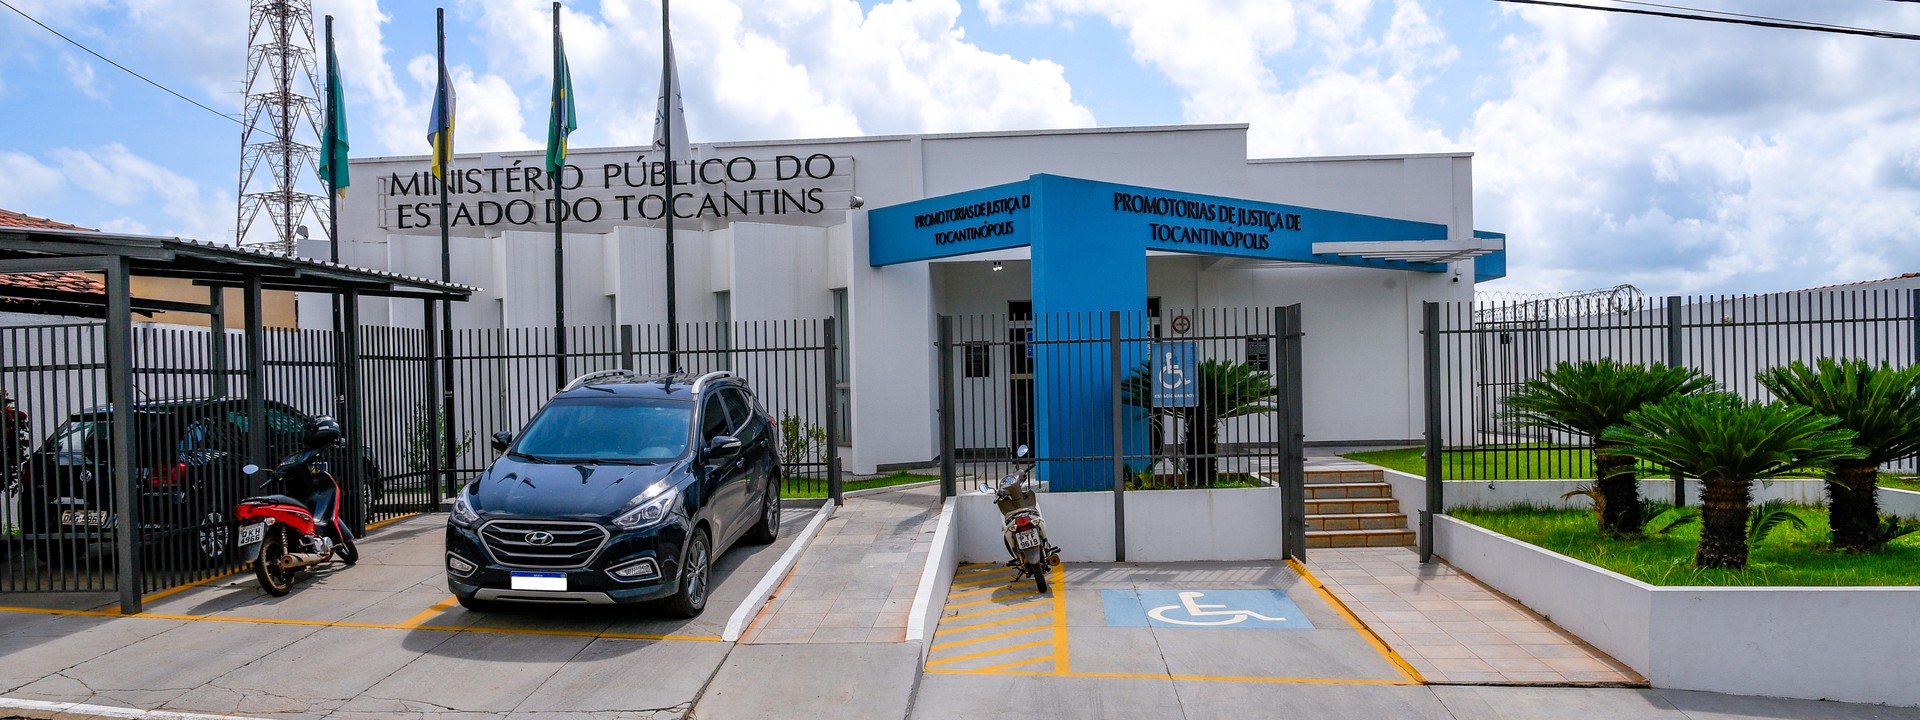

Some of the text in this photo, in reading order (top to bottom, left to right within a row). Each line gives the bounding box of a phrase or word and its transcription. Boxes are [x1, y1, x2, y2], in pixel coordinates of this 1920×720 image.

[390, 153, 835, 196] MINISTÉRIO PÚBLICO DO
[397, 188, 824, 229] ESTADO DO TOCANTINS
[914, 193, 1030, 229] PROMOTORIAS DE JUSTIÇA D
[1114, 192, 1301, 232] PROMOTORIAS DE JUSTIÇA DE
[934, 220, 1014, 245] TOCANTINÓPOLIS
[1149, 223, 1269, 250] TOCANTINÓPOLIS
[1020, 538, 1039, 548] 9619
